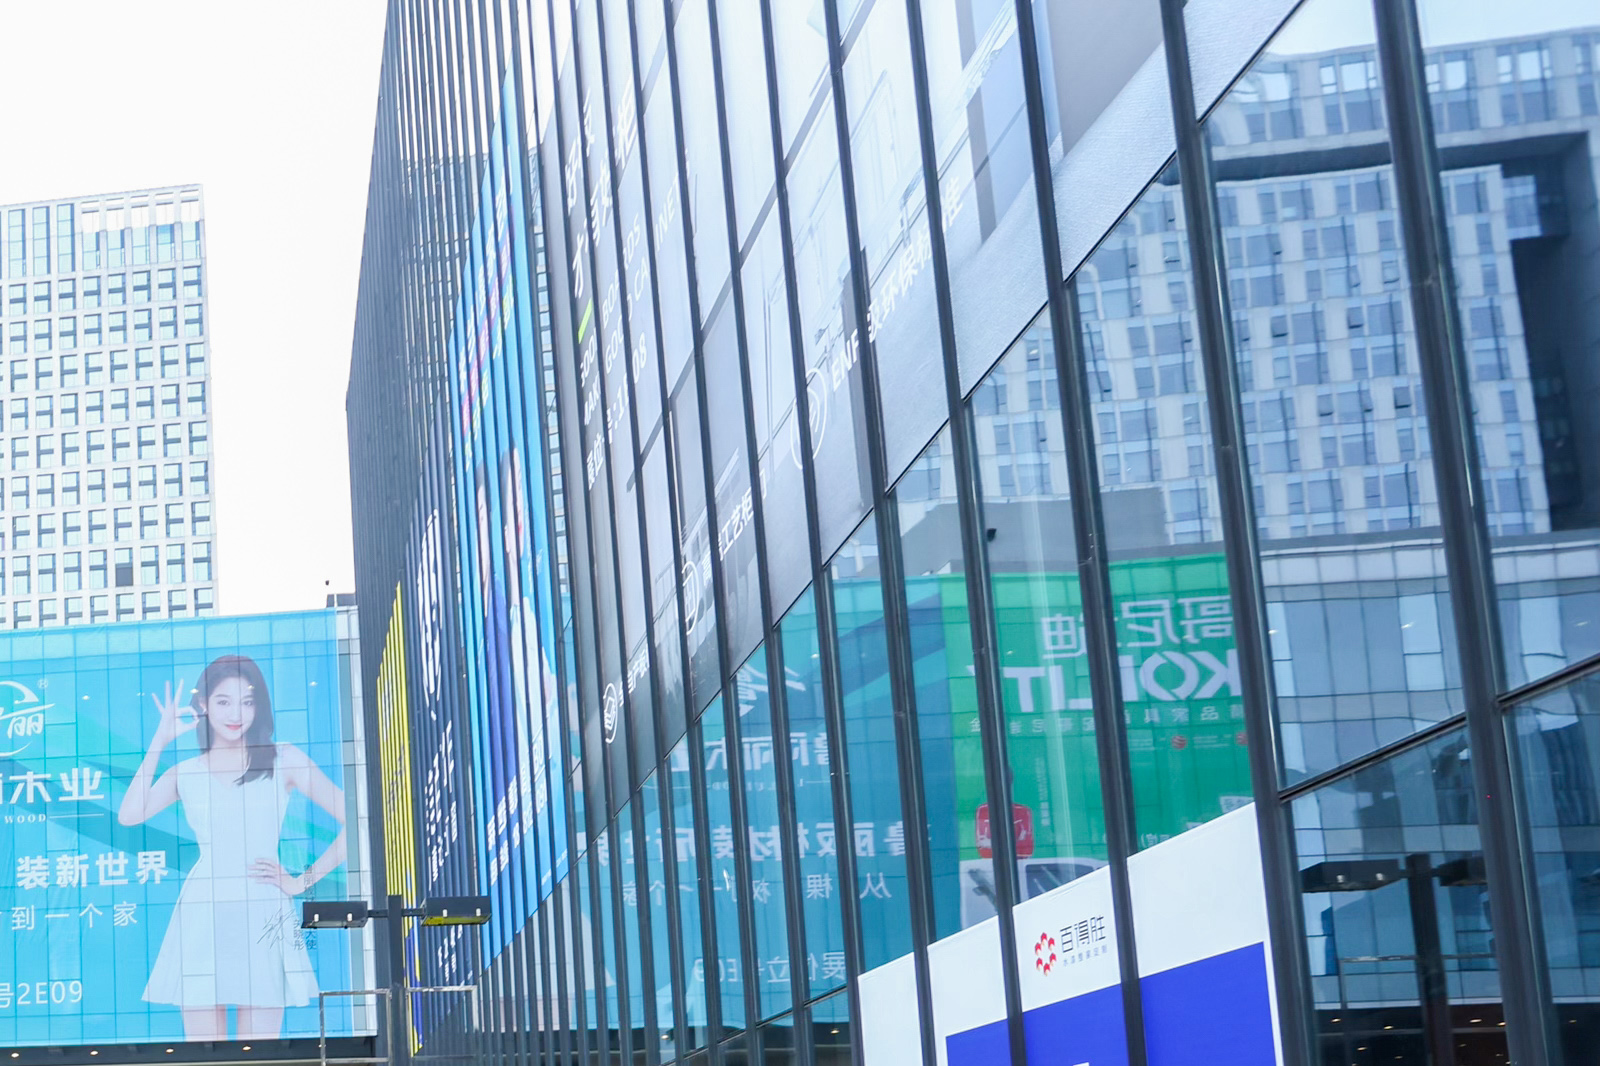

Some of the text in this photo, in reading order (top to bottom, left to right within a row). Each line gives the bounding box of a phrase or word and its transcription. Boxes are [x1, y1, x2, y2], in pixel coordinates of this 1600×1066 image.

[4, 813, 47, 825] WOOD
[16, 850, 168, 890] 装新世界
[1060, 915, 1106, 954] 百得胜
